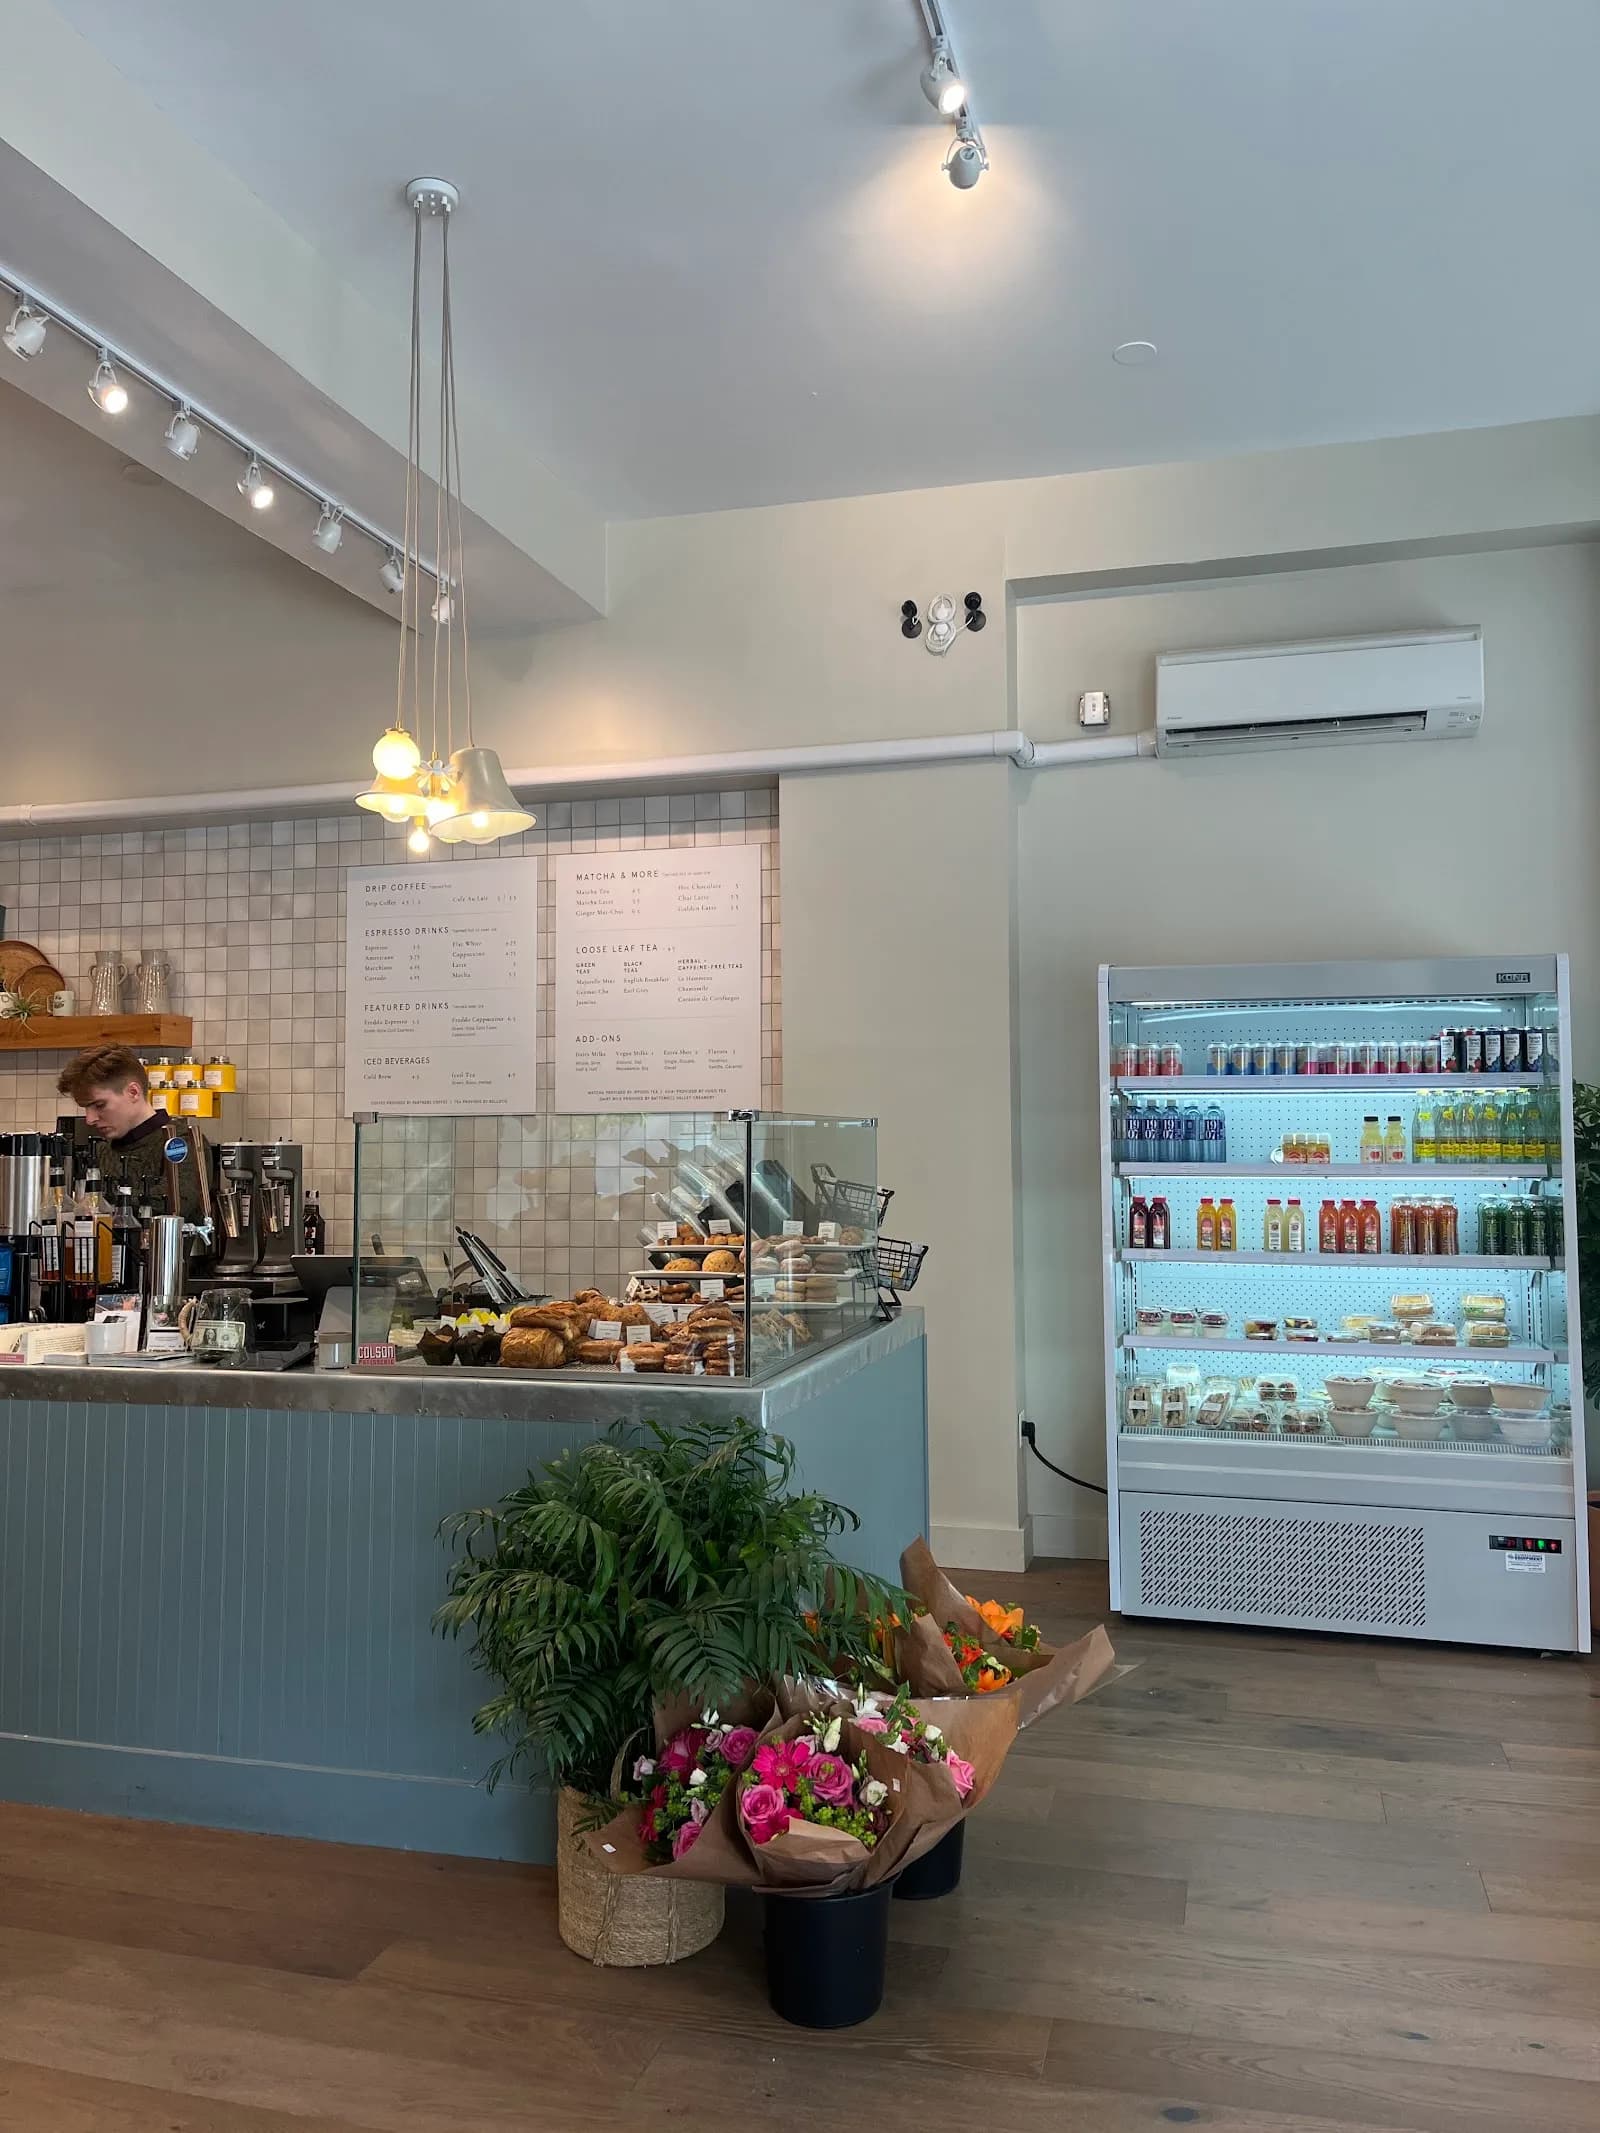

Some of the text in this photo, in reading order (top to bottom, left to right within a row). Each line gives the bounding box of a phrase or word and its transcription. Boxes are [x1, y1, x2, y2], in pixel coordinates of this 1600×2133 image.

[365, 884, 386, 893] DRIP
[391, 883, 426, 891] COFFEE
[365, 928, 410, 936] ESPRESSO
[416, 927, 448, 935] DRINKS
[364, 1003, 410, 1012] FEATURED
[1129, 1120, 1139, 1130] 19
[1146, 1120, 1156, 1130] 19
[1164, 1120, 1174, 1130] 19
[1207, 1120, 1217, 1130] 19
[1128, 1129, 1139, 1139] 07
[1145, 1129, 1156, 1139] 07
[1163, 1129, 1174, 1139] 07
[1205, 1130, 1216, 1139] 07
[358, 1346, 394, 1359] COLSON
